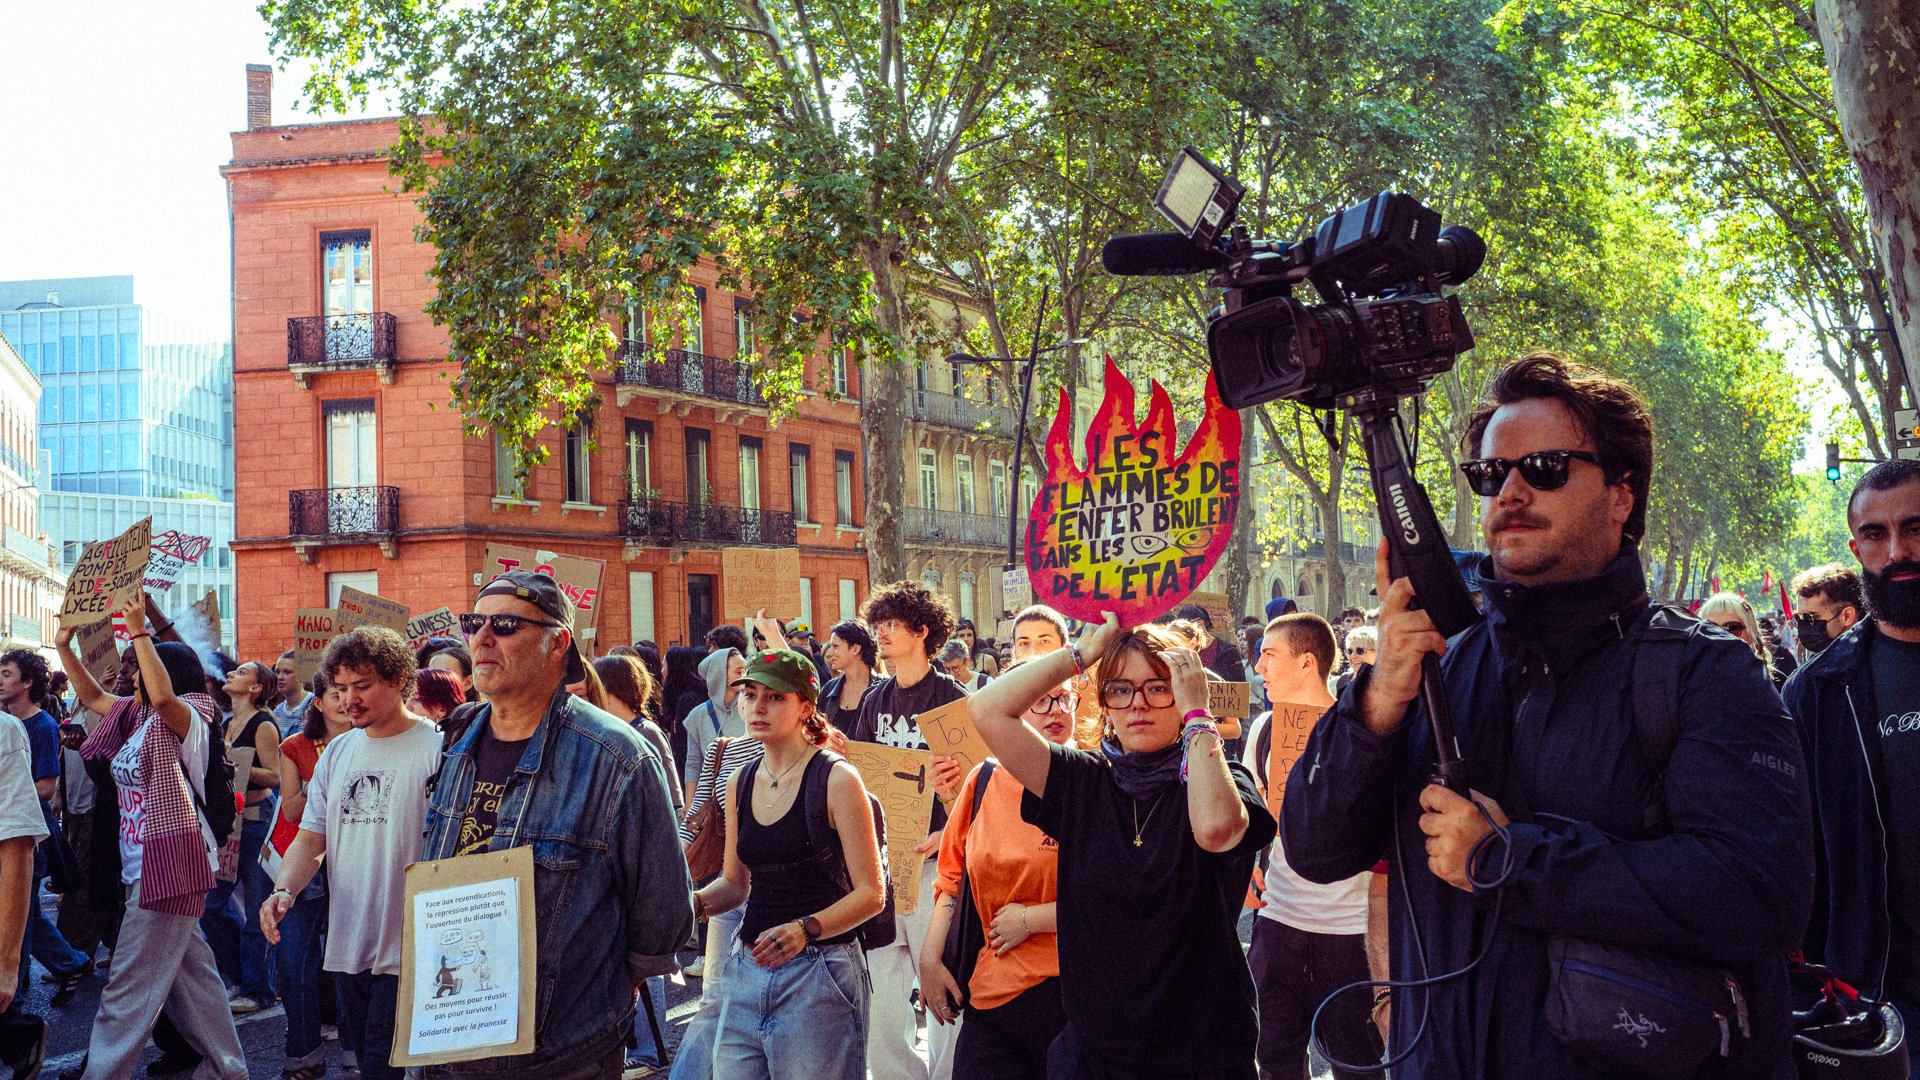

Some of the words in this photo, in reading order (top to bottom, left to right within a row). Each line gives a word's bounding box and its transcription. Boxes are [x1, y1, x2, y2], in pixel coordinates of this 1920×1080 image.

[1093, 430, 1161, 475] LES
[1041, 463, 1191, 513] FLAMMES
[1199, 460, 1239, 495] DE
[1029, 503, 1145, 549] L'ENFER
[1152, 495, 1240, 533] BRULENT
[1388, 483, 1420, 545] Canon
[81, 520, 149, 563] AGRICULTEUR
[1029, 542, 1082, 574] DANS
[1089, 537, 1125, 565] LES
[73, 556, 128, 578] POMPIER
[1052, 572, 1085, 600] DE
[1093, 554, 1205, 601] L'ÉTAT
[64, 591, 117, 615] LYCÉEN
[340, 600, 363, 614] TROU
[298, 637, 332, 651] PROF
[1209, 684, 1237, 695] ENIR
[927, 713, 968, 746] Toi
[1283, 708, 1308, 729] NE
[1877, 714, 1898, 738] No
[888, 764, 926, 854] TROP
[425, 900, 441, 909] Face
[441, 898, 454, 906] aux
[455, 889, 506, 903] revendications,
[427, 911, 434, 919] la
[434, 905, 469, 918] répression
[470, 901, 491, 913] plutôt
[491, 900, 505, 910] que
[425, 918, 462, 930] l'ouverture
[463, 915, 472, 923] du
[473, 910, 503, 922] dialogue
[425, 1003, 438, 1011] Des
[439, 999, 466, 1009] moyens
[466, 996, 484, 1006] pour
[484, 991, 508, 1000] réussir
[434, 1011, 446, 1021] pas
[447, 1009, 465, 1019] pour
[465, 1006, 493, 1016] survivre
[418, 1024, 451, 1038] Solidarité
[452, 1023, 469, 1032] avec
[469, 1021, 477, 1030] la
[476, 1018, 508, 1031] jeunesse
[1807, 1052, 1840, 1067] oxelo
